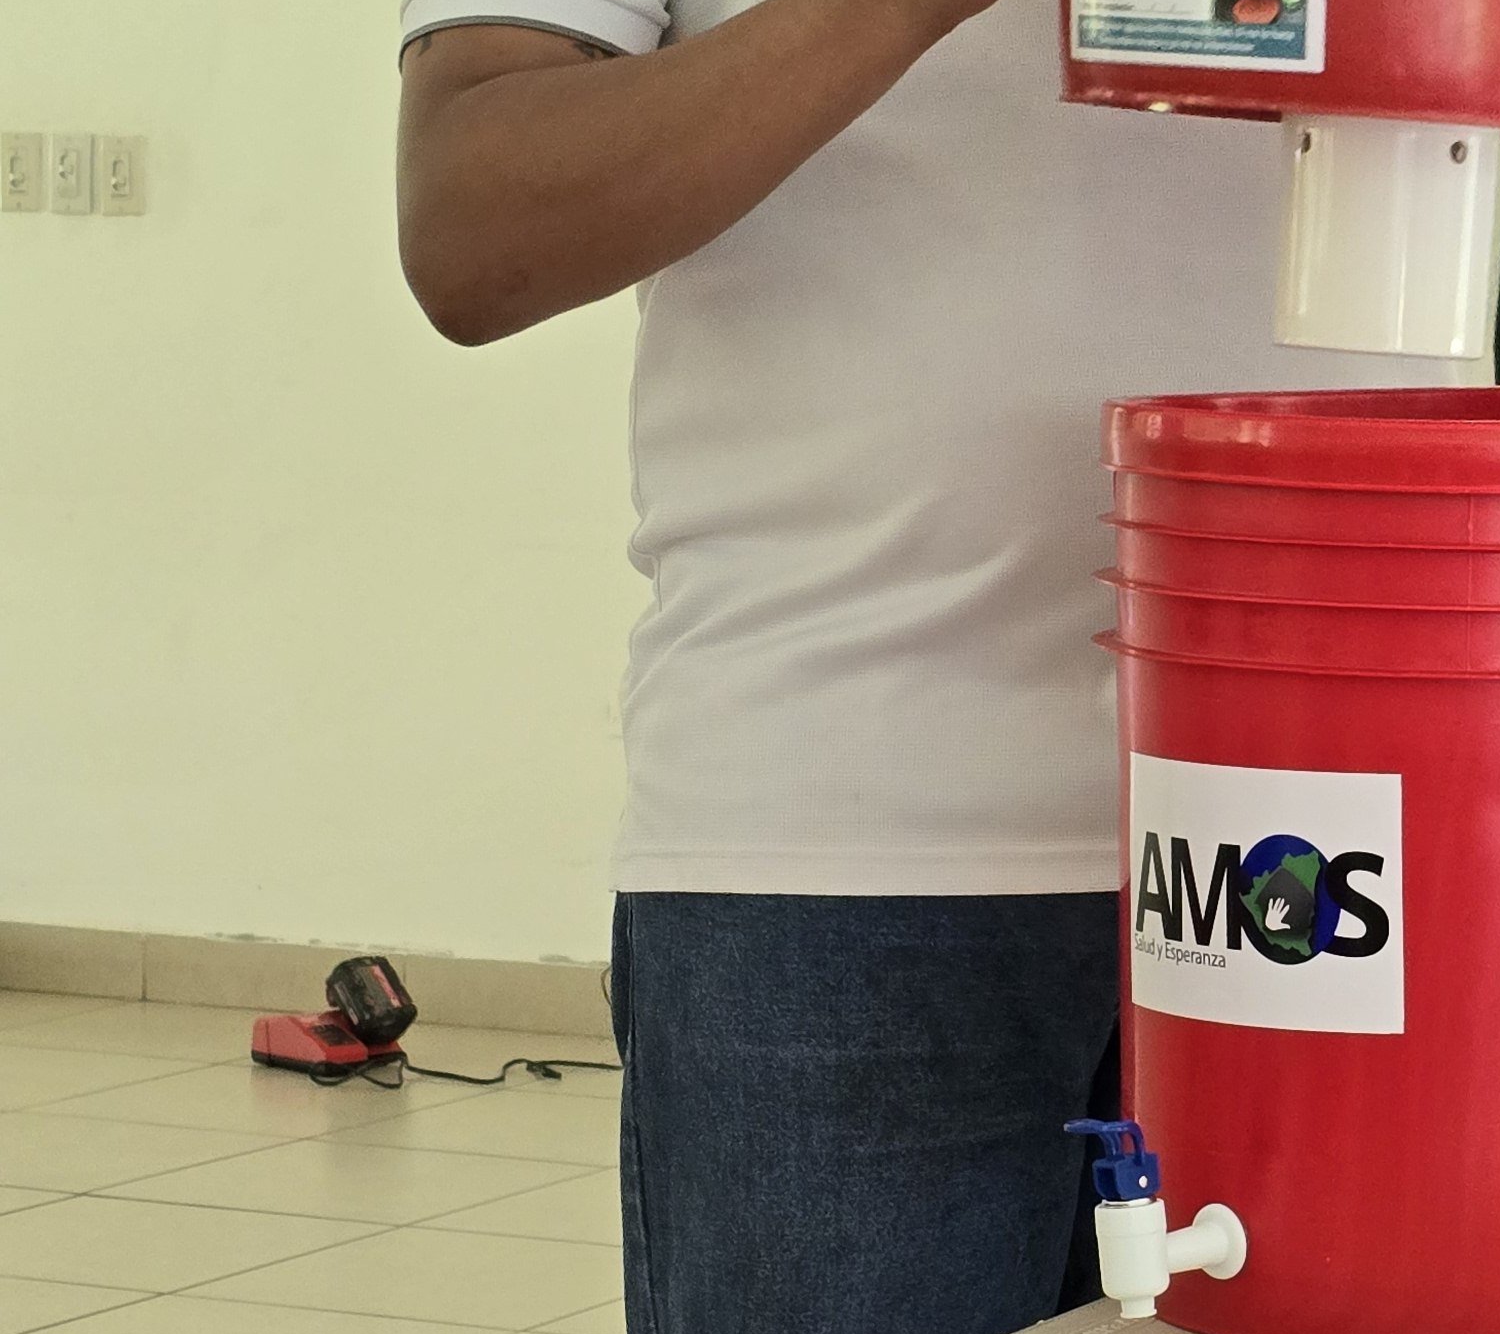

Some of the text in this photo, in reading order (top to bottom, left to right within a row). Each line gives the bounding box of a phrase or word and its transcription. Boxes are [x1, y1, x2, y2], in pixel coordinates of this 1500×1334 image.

[1135, 831, 1390, 965] AMOS
[1134, 932, 1227, 969] Salud y Esperanza
